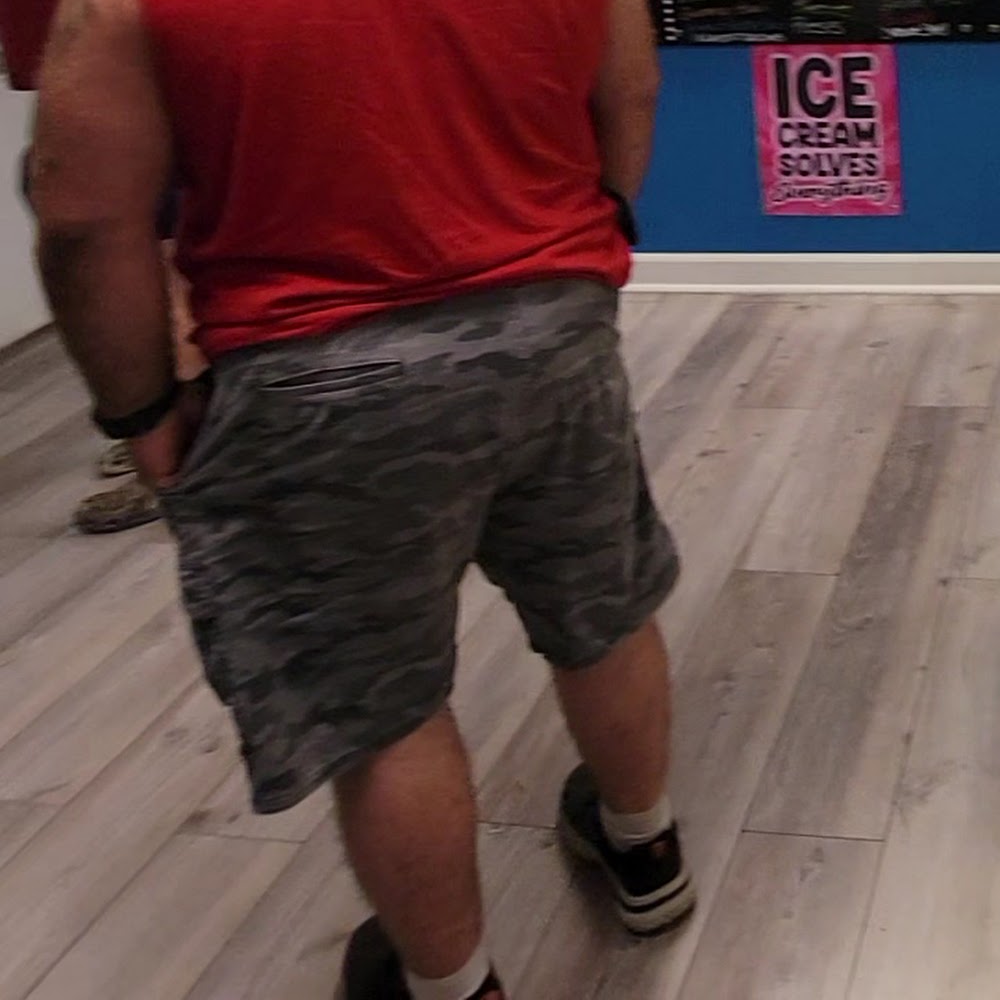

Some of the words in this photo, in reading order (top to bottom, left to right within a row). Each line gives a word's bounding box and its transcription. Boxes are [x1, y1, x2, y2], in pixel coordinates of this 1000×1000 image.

[773, 56, 876, 119] ICE
[777, 121, 878, 149] CREAM
[778, 152, 879, 177] SOLVES
